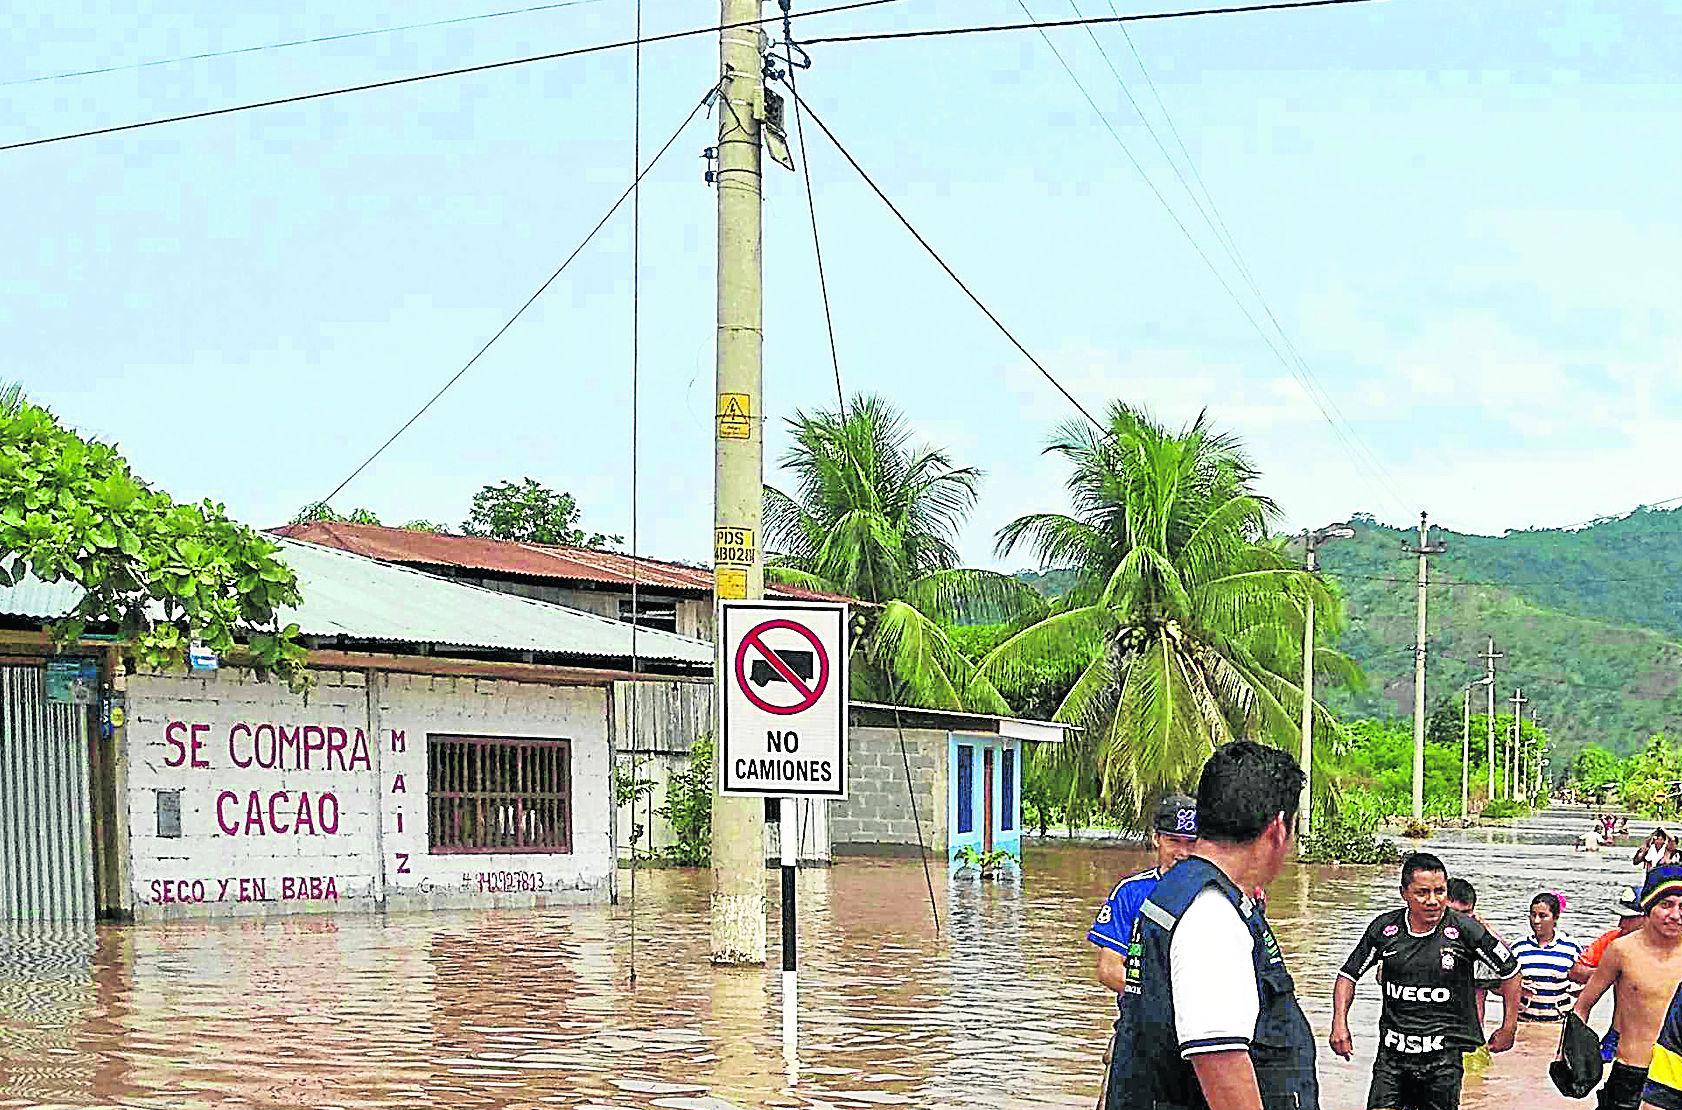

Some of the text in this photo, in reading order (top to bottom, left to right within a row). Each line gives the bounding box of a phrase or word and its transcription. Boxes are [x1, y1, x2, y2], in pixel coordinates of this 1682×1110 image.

[164, 721, 371, 771] SE COMPRA
[767, 730, 799, 753] NO
[735, 758, 832, 782] CAMIONES
[216, 790, 339, 836] CACAO
[151, 877, 339, 902] SECO Y EN BABA
[1386, 981, 1451, 1003] IVECO
[1384, 1029, 1446, 1054] FISK
